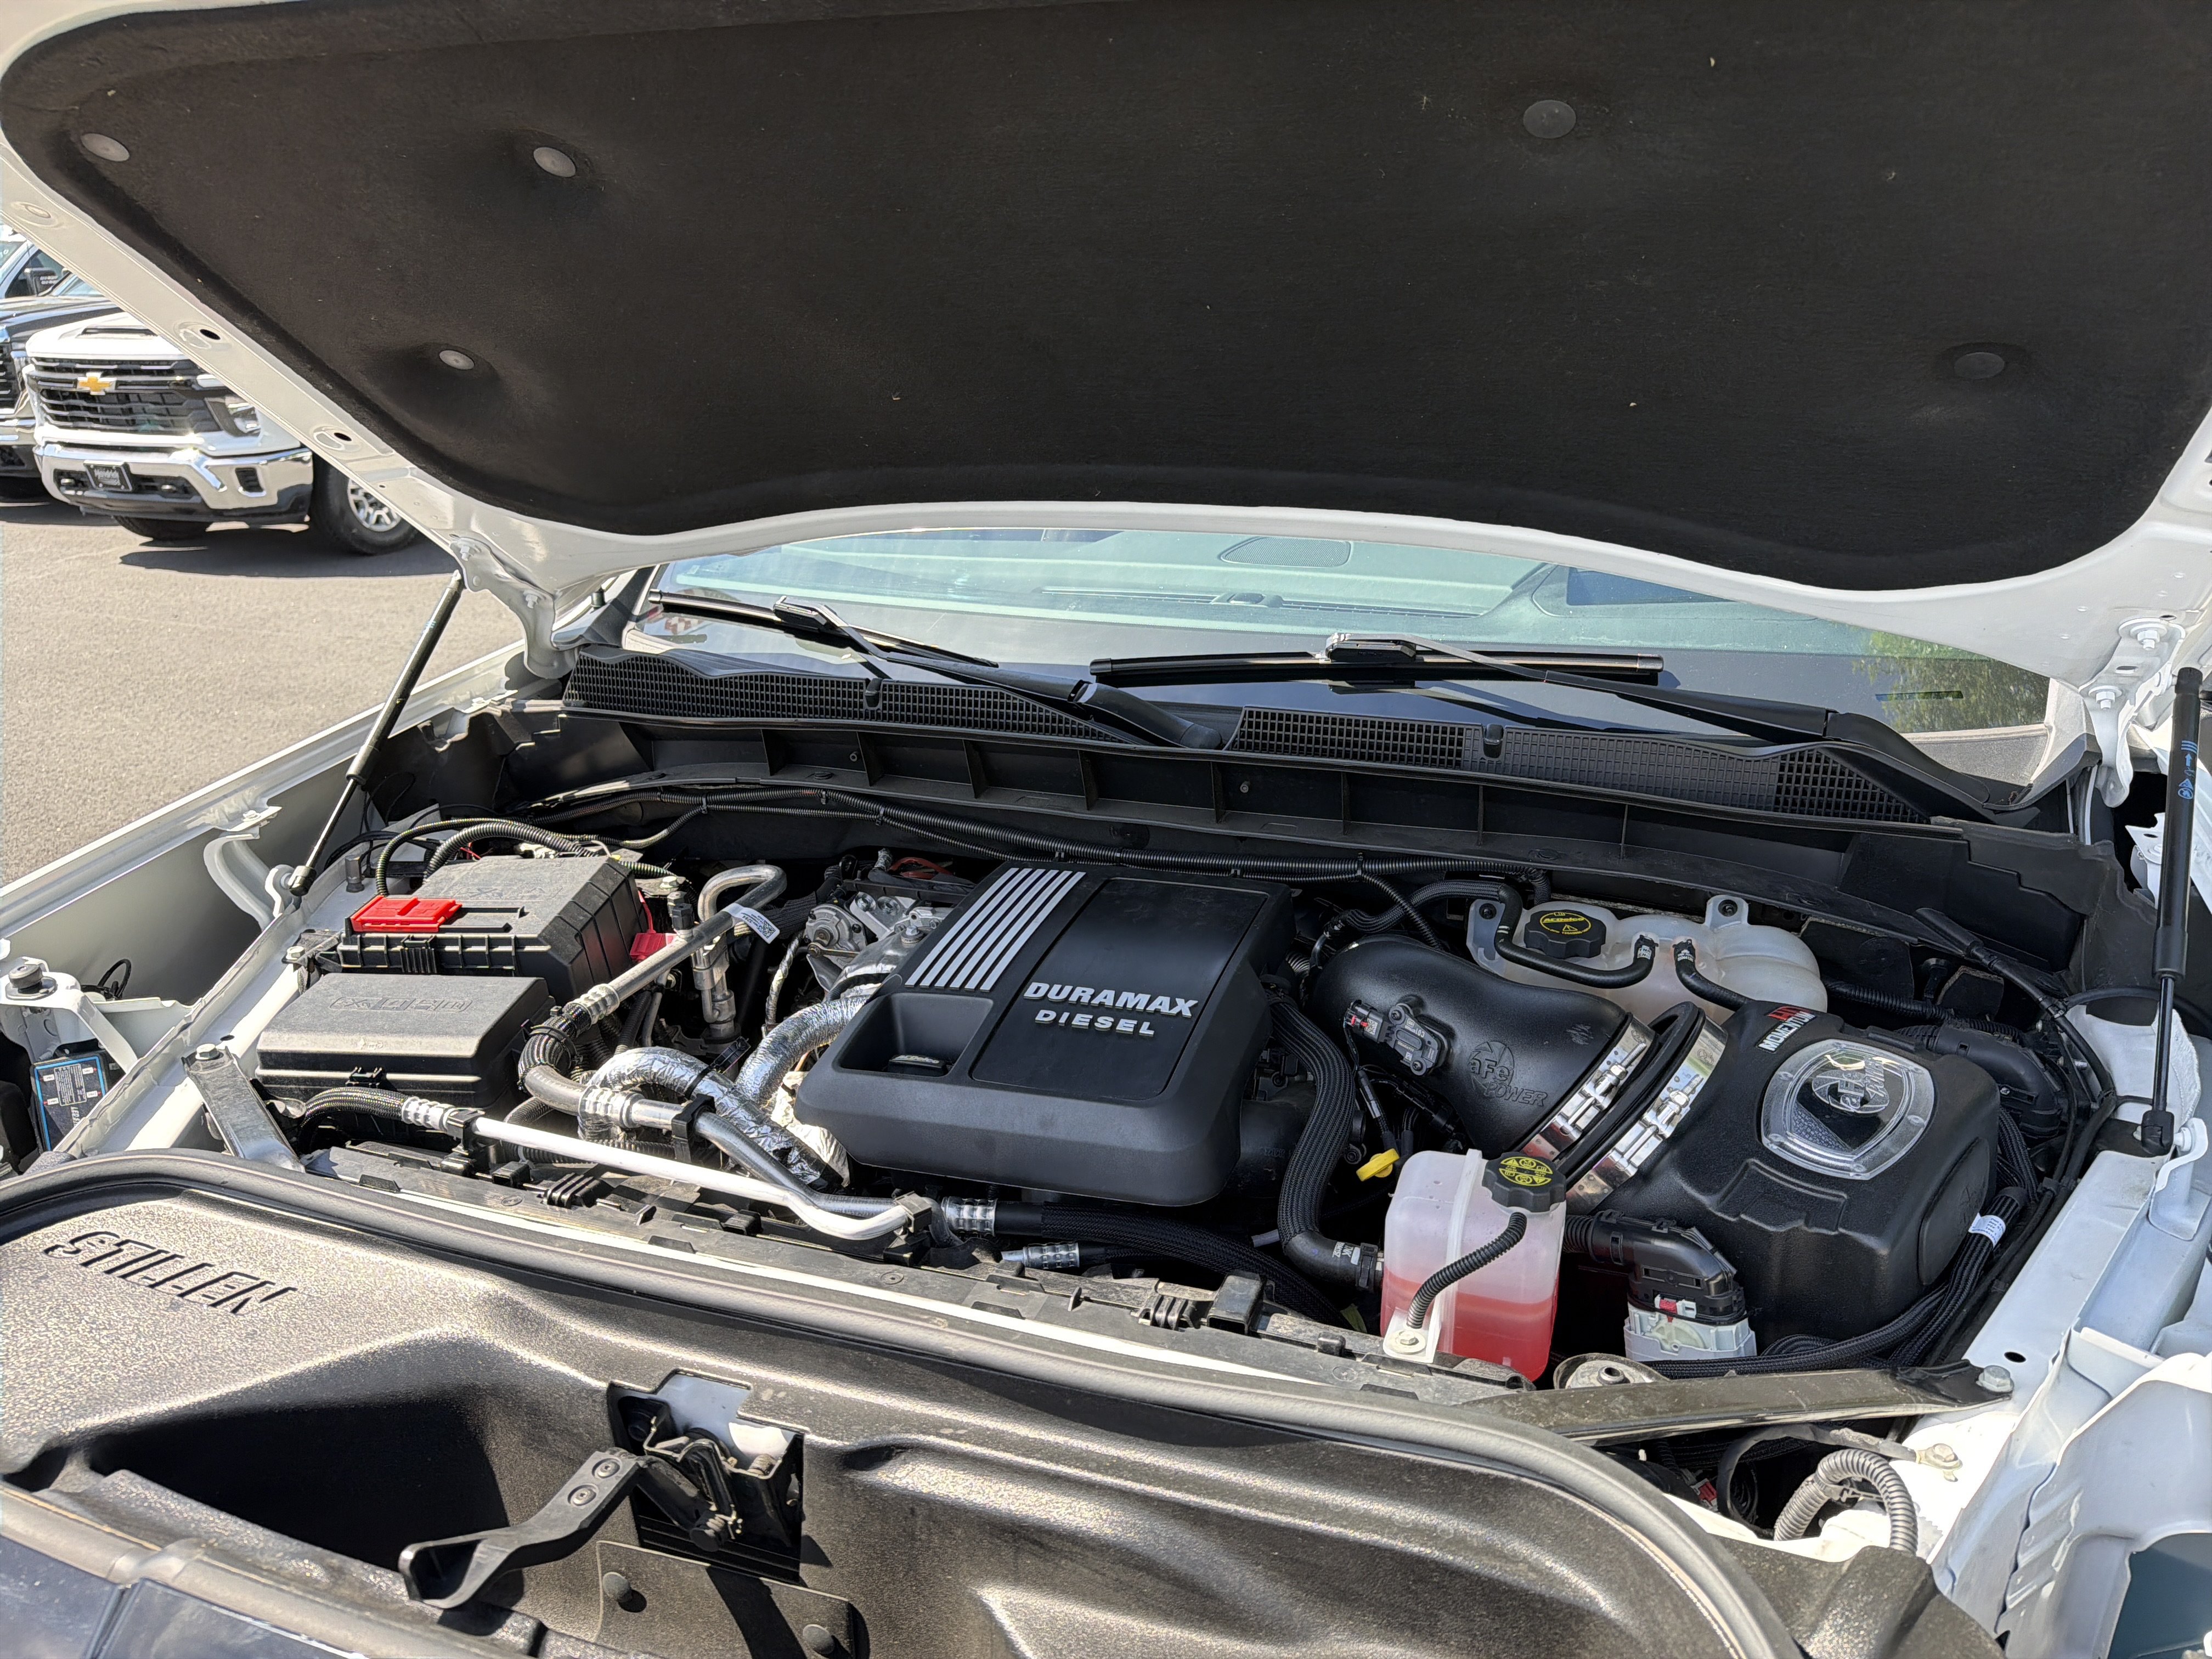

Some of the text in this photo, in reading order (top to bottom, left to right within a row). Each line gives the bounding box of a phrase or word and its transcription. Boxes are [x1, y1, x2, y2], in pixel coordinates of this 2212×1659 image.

[1024, 981, 1199, 1018] DURAMAX
[1035, 1009, 1155, 1037] DIESEL
[1758, 1011, 1815, 1052] MOMENTUM
[1469, 1057, 1510, 1082] aFe
[1483, 1081, 1549, 1107] POWER
[43, 1230, 298, 1314] STILLEN
